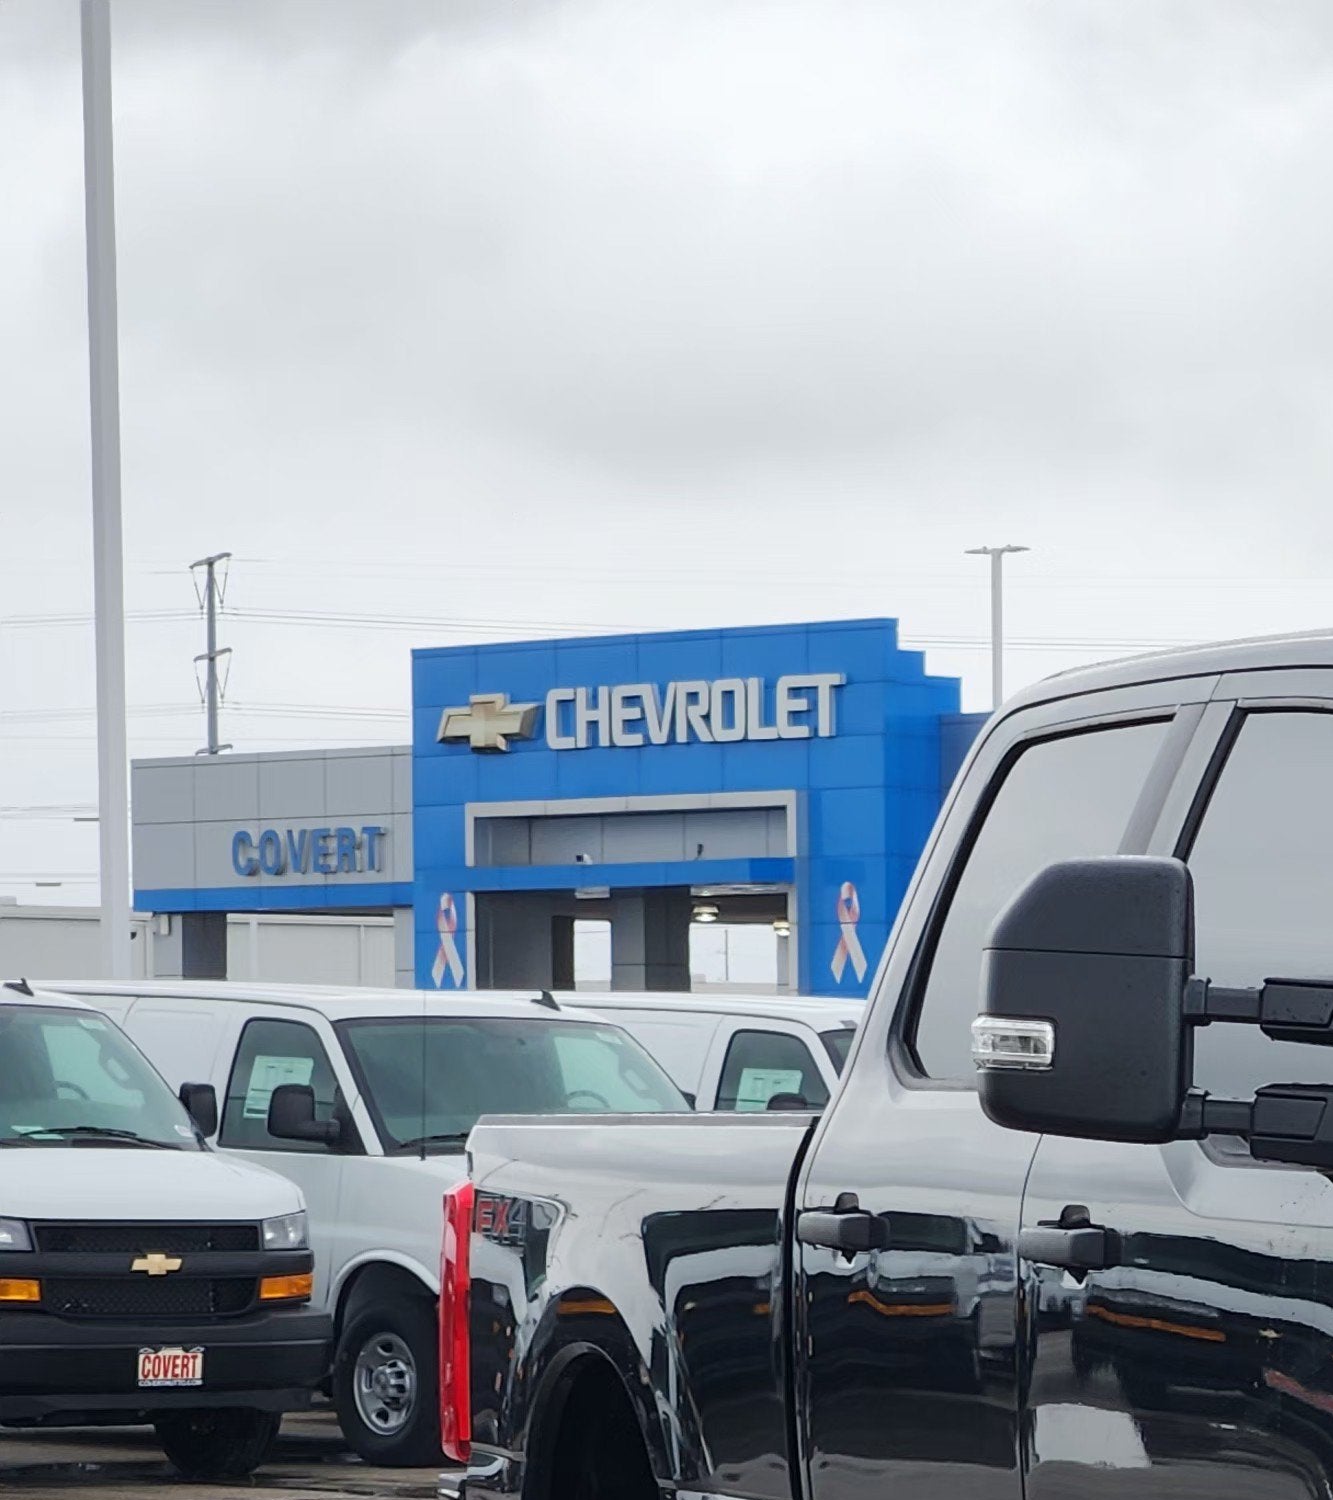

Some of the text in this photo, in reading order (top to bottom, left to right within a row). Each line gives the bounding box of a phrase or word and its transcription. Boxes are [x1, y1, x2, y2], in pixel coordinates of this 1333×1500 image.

[545, 672, 847, 751] CHEVROLET
[231, 826, 387, 877] COVERT
[141, 1354, 198, 1379] COVERT
